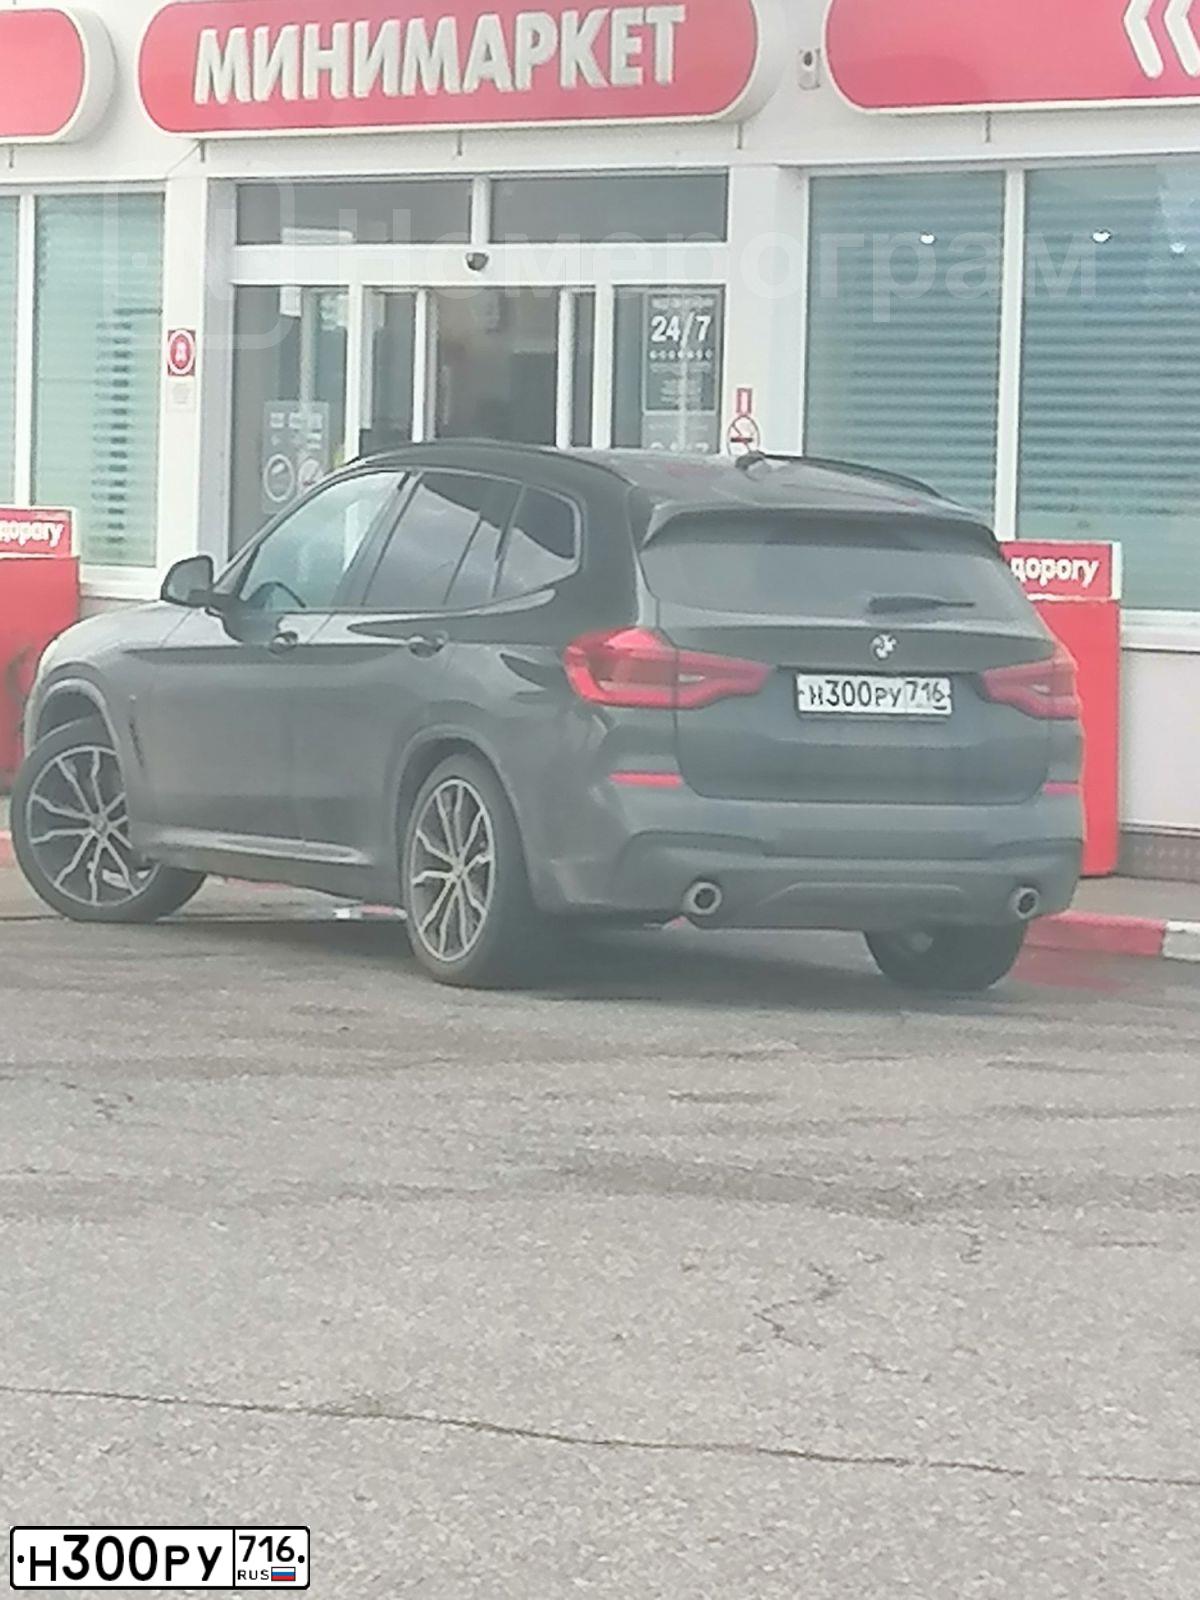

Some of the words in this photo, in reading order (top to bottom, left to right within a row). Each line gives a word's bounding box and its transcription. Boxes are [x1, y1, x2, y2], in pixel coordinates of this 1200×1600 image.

[194, 3, 686, 105] МИНИМАРКЕТ
[651, 311, 712, 348] 24/7
[1010, 557, 1099, 588] дорогу
[809, 680, 901, 707] Н300РУ
[905, 681, 946, 702] 716
